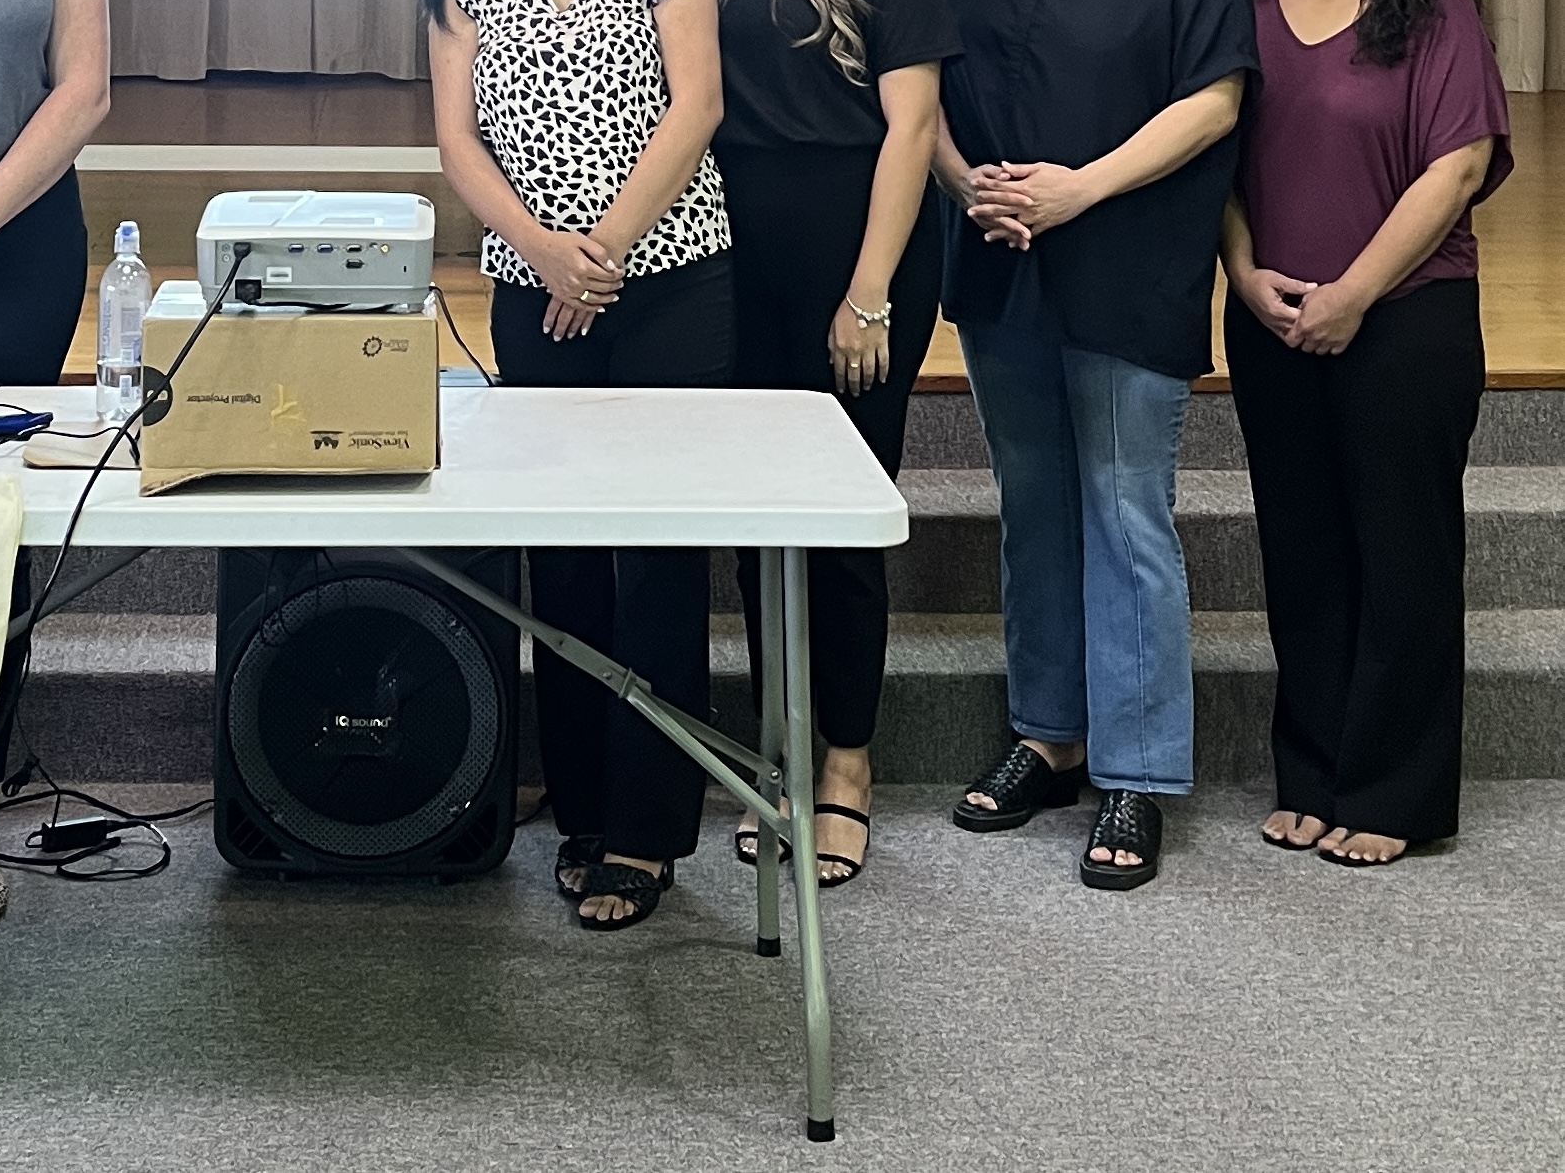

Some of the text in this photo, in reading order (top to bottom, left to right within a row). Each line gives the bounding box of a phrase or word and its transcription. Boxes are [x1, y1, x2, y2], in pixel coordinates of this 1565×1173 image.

[187, 393, 261, 405] Digital Projector
[349, 437, 410, 450] ViewSonic
